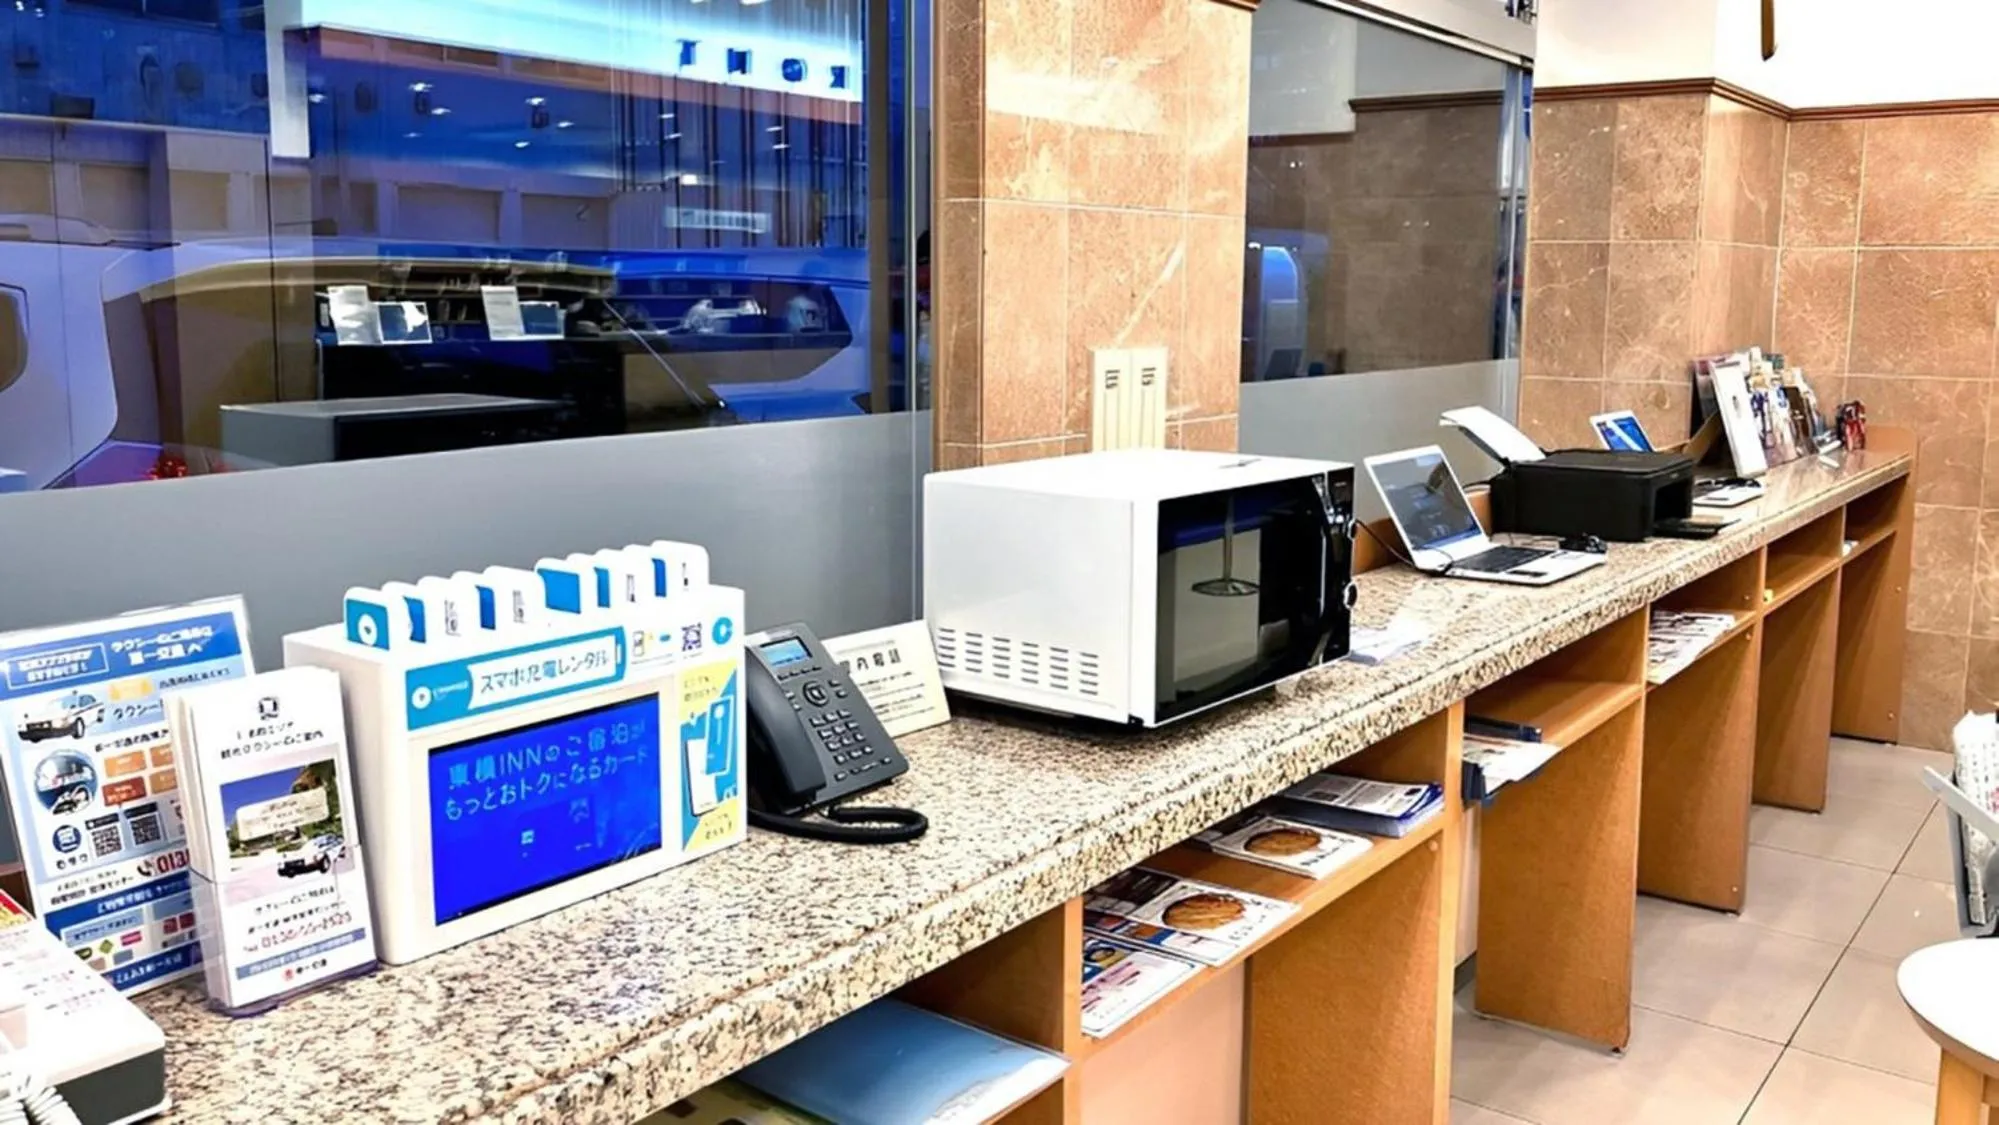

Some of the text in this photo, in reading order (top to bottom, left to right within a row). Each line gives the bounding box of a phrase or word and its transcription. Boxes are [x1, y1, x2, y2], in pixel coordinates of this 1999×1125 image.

[481, 650, 608, 693] スマホ充電レンタル
[446, 748, 647, 820] もっとおトクになるカード
